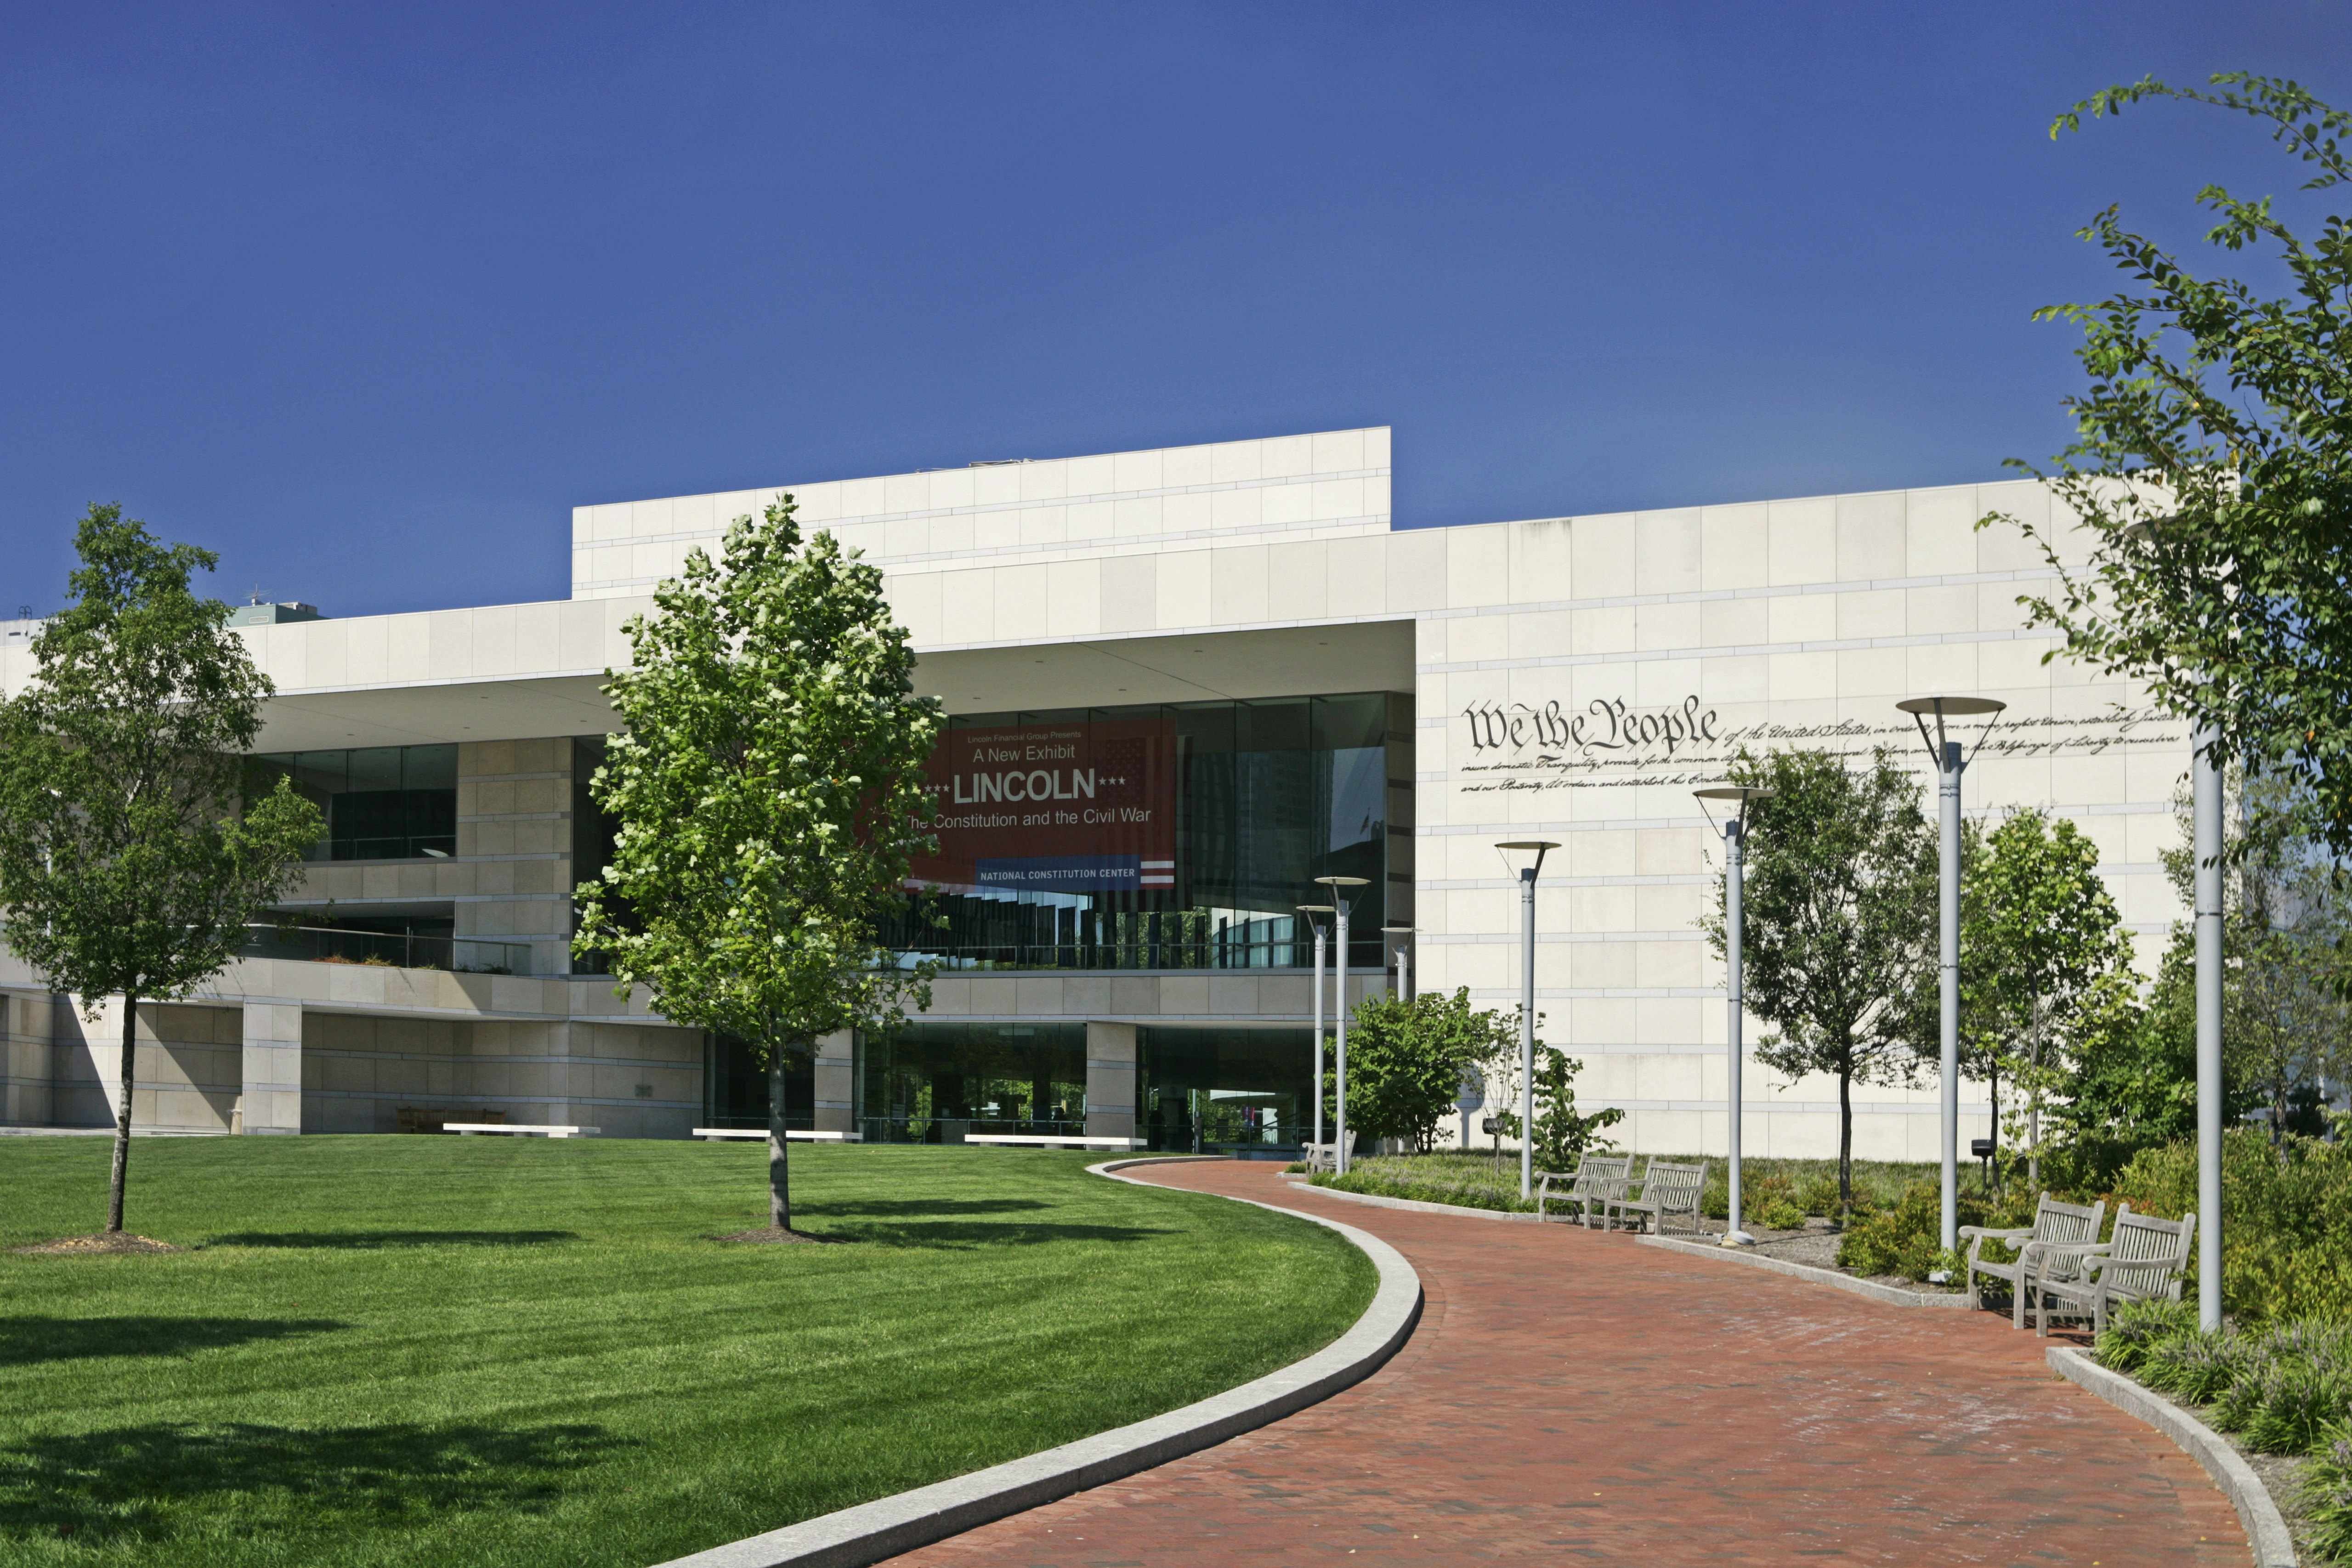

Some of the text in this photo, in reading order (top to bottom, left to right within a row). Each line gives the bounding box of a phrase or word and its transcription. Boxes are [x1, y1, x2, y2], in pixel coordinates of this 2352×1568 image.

[1461, 699, 1534, 757] We
[1533, 700, 1595, 754] the
[1583, 695, 1726, 756] People
[1724, 726, 1748, 747] of
[1743, 722, 1768, 740] the
[1768, 723, 1822, 738] United
[1873, 722, 1887, 734] in
[1995, 717, 2040, 733] perfect
[2079, 711, 2136, 725] establish
[994, 734, 1025, 742] Financial
[1026, 733, 1048, 741] Group
[973, 744, 1076, 763] A New Exhibit
[1491, 760, 1534, 770] domestic
[1600, 756, 1642, 769] provide
[1637, 754, 1658, 770] for
[1657, 755, 1671, 764] the
[2050, 738, 2071, 754] of
[2065, 735, 2112, 755] Liberty
[2124, 733, 2180, 744] ourselves
[953, 768, 1095, 804] LINCOLN
[1461, 784, 1483, 792] and
[1499, 778, 1544, 794] Posterity,
[1563, 779, 1597, 788] ordain
[1598, 779, 1622, 787] and
[1621, 774, 1669, 786] establish
[1667, 773, 1686, 785] this
[934, 813, 1017, 828] Constitution
[1023, 810, 1049, 826] and
[1055, 810, 1078, 824] the
[1083, 808, 1115, 823] Civil
[1120, 808, 1151, 822] War
[980, 869, 1135, 881] NATIONAL CONSTITUTION CENTER
